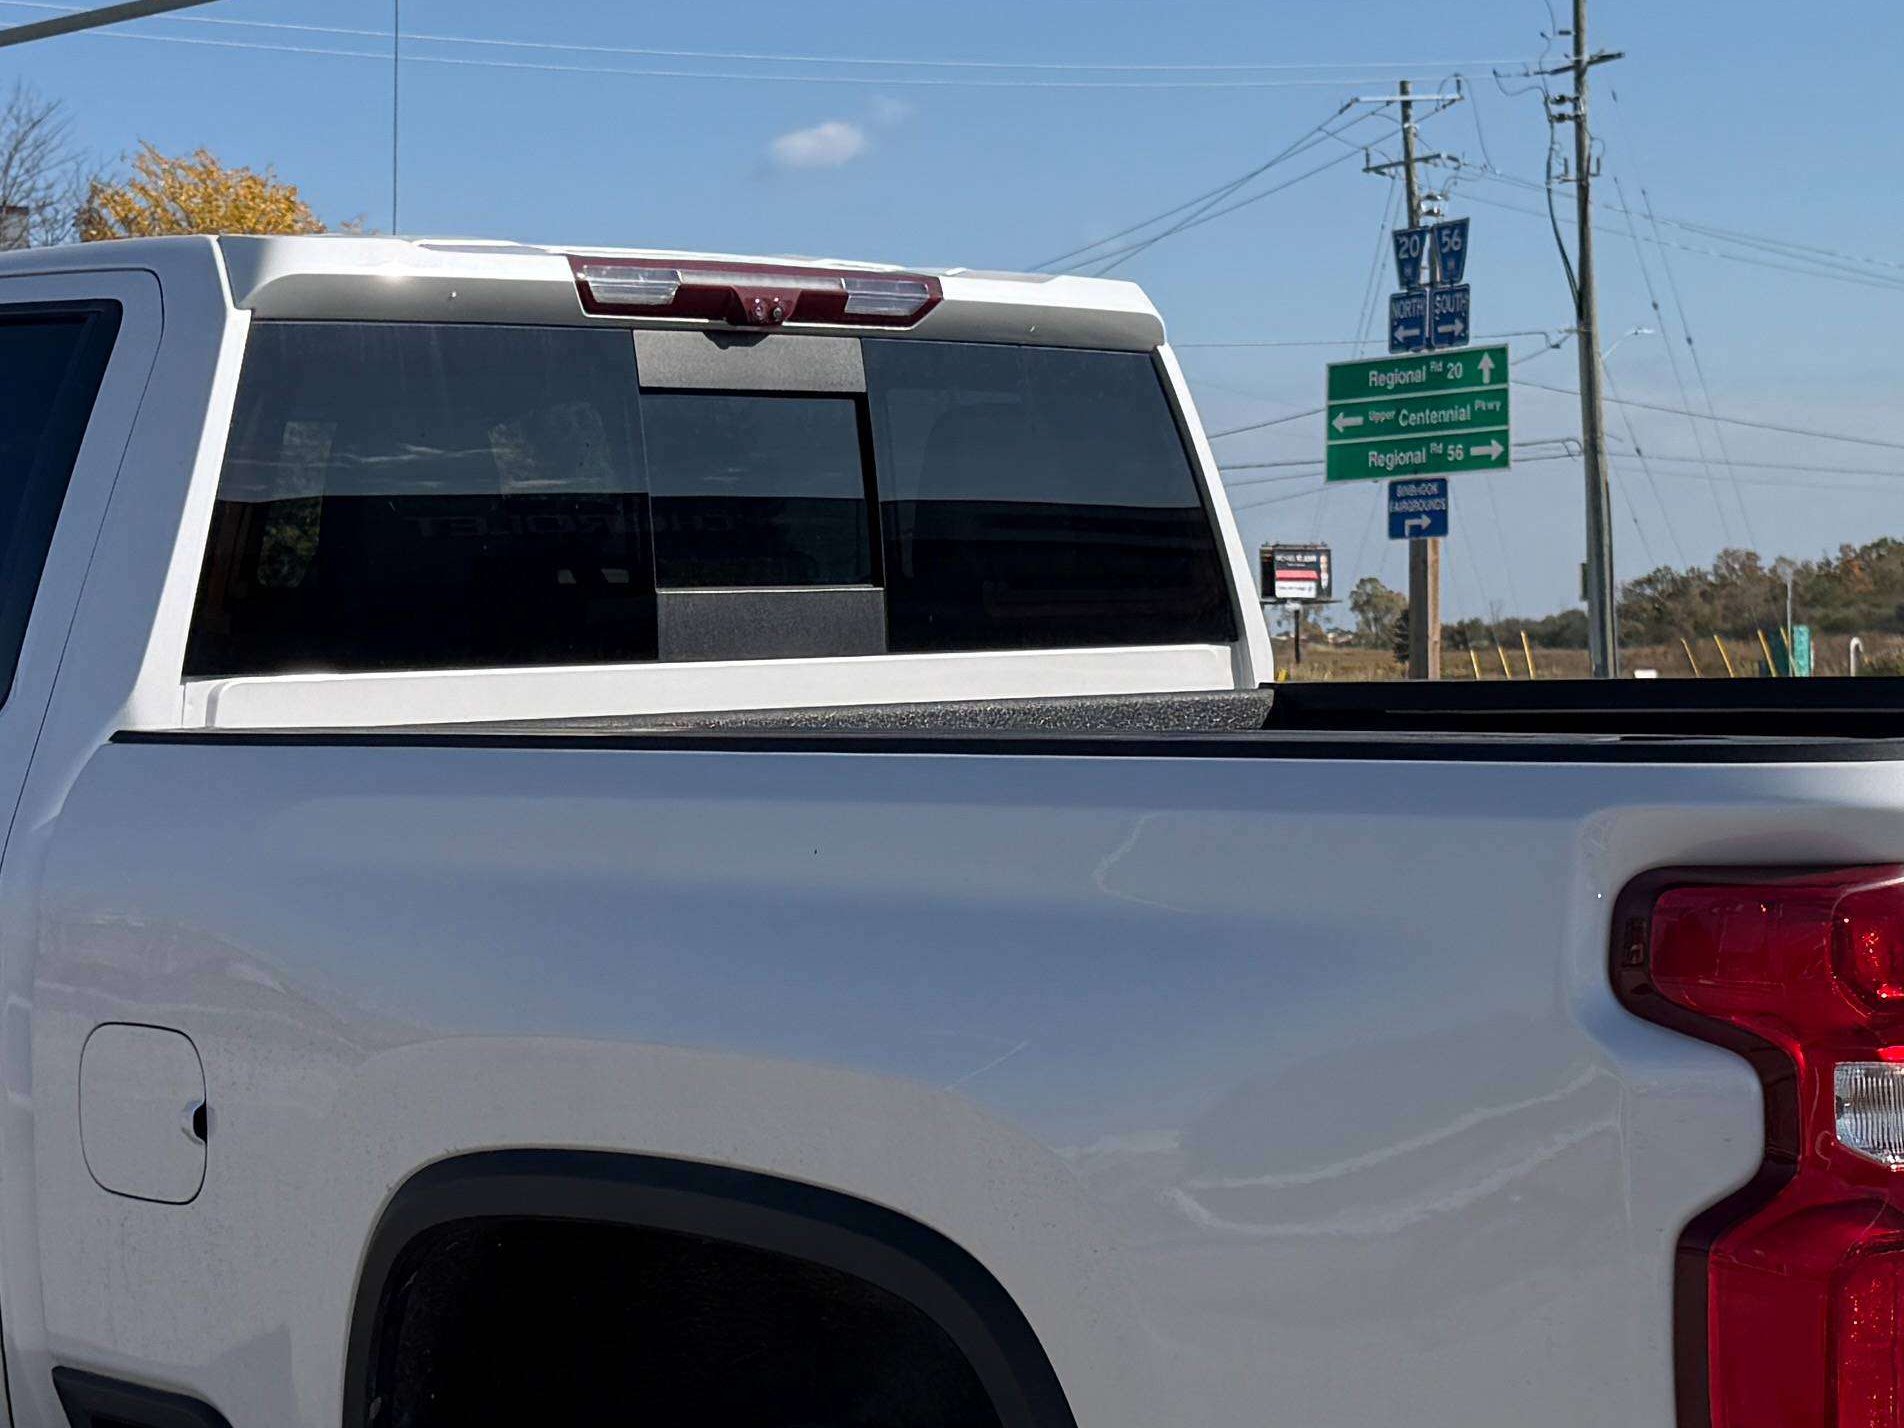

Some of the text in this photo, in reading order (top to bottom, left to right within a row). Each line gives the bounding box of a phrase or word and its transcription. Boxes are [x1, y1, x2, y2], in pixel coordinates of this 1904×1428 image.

[1397, 234, 1420, 259] 20
[1441, 228, 1462, 253] 56
[1393, 297, 1426, 319] NORTH
[1435, 292, 1467, 315] SOUTH
[1369, 361, 1463, 389] Regional Rd 20
[1368, 399, 1502, 427] Upper Centennial Pkwy
[1368, 443, 1464, 471] Regional Rd 56
